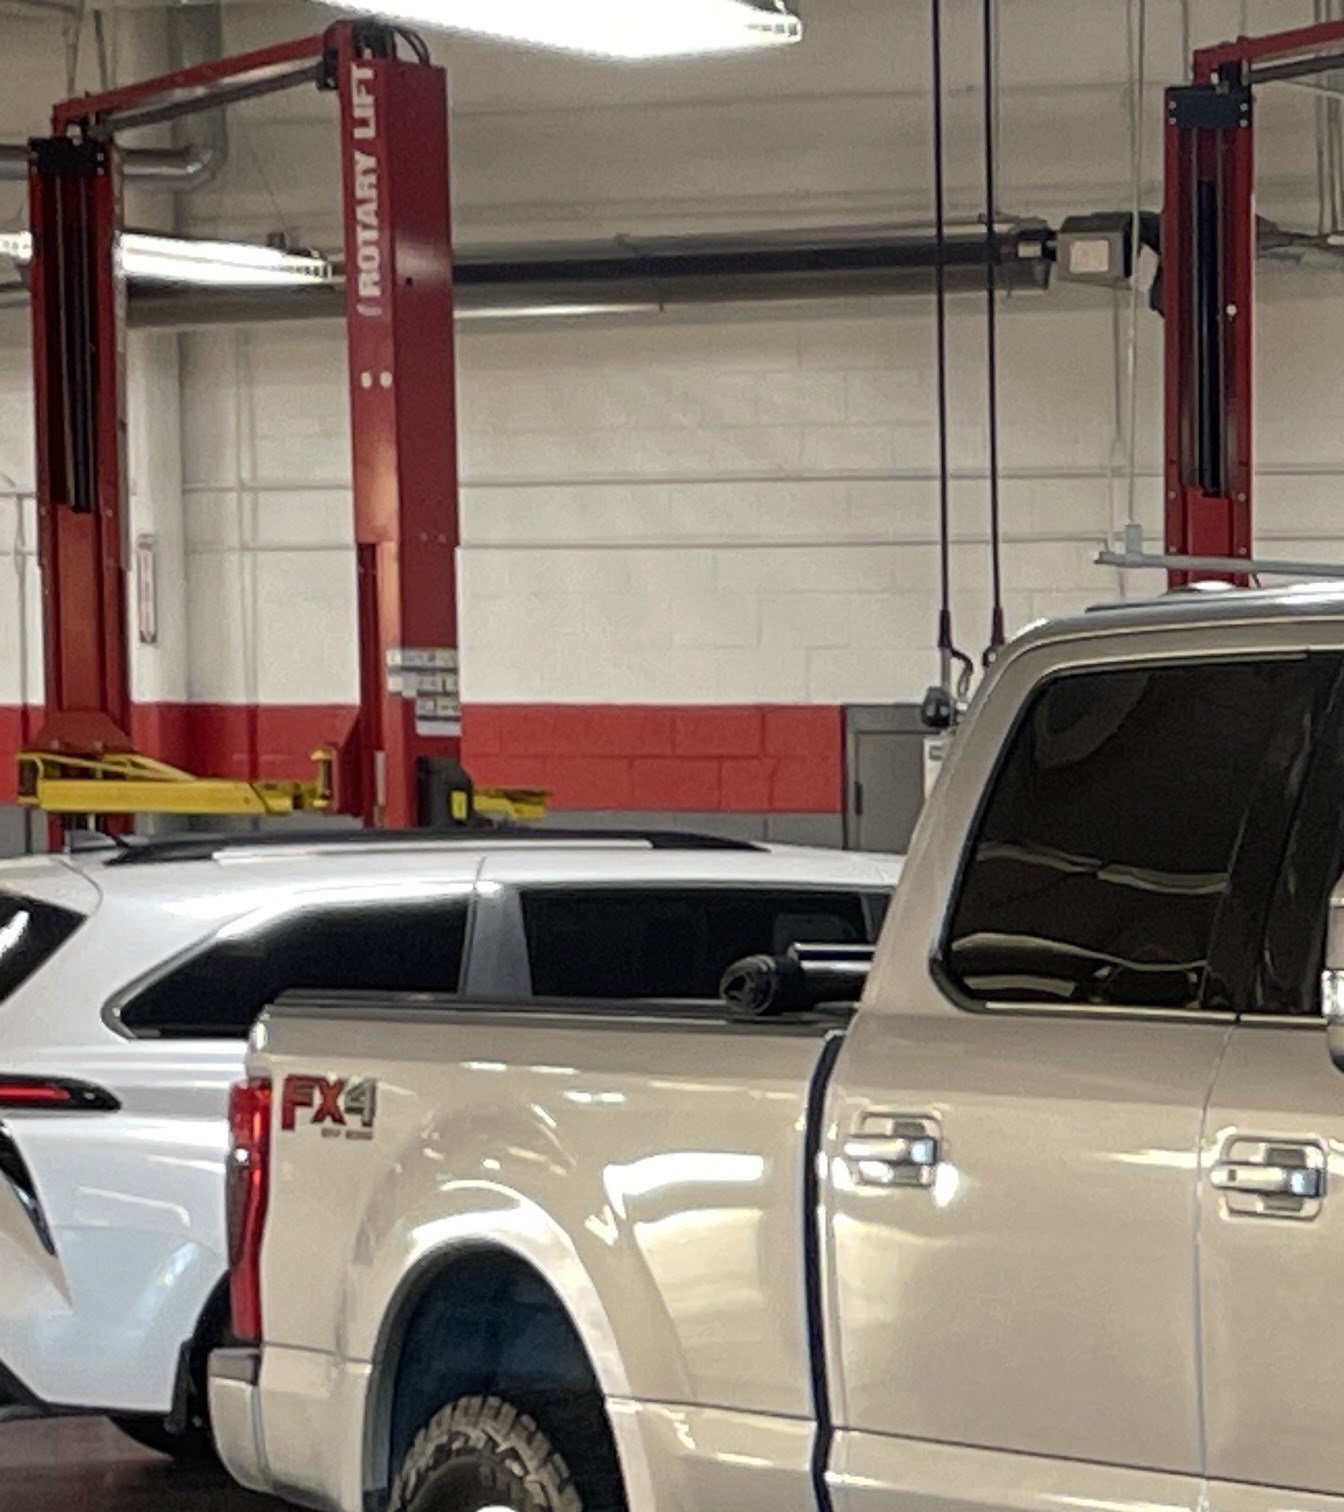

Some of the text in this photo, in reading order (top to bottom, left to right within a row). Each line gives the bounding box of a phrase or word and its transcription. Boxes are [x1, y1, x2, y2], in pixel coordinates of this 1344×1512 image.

[352, 62, 382, 296] ROTARY LIFT
[281, 1074, 377, 1131] FX4
